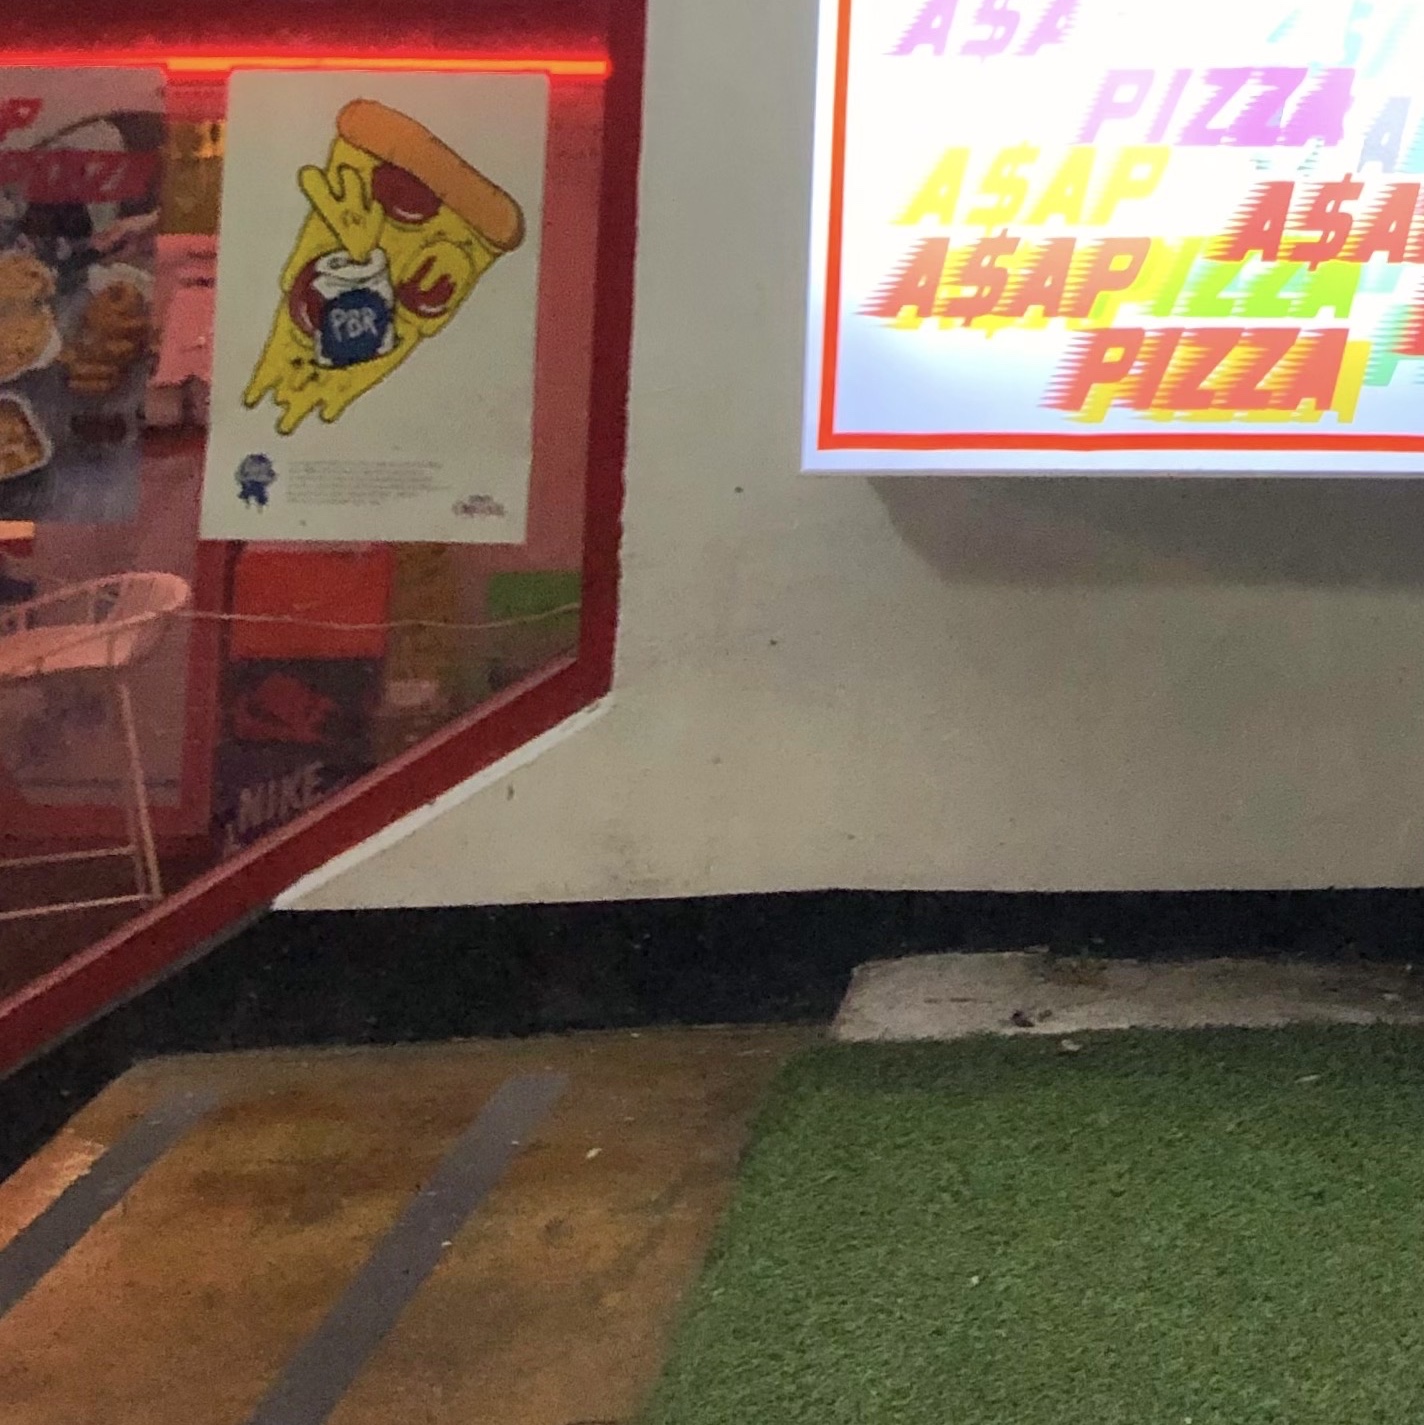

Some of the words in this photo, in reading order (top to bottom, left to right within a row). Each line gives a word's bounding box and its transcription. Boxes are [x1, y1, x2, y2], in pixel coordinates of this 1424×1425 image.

[1068, 65, 1356, 148] PIZZA
[888, 140, 1172, 236] A$AP
[854, 227, 1153, 328] A$AP
[329, 306, 378, 342] PBR
[1036, 326, 1351, 412] PIZZA
